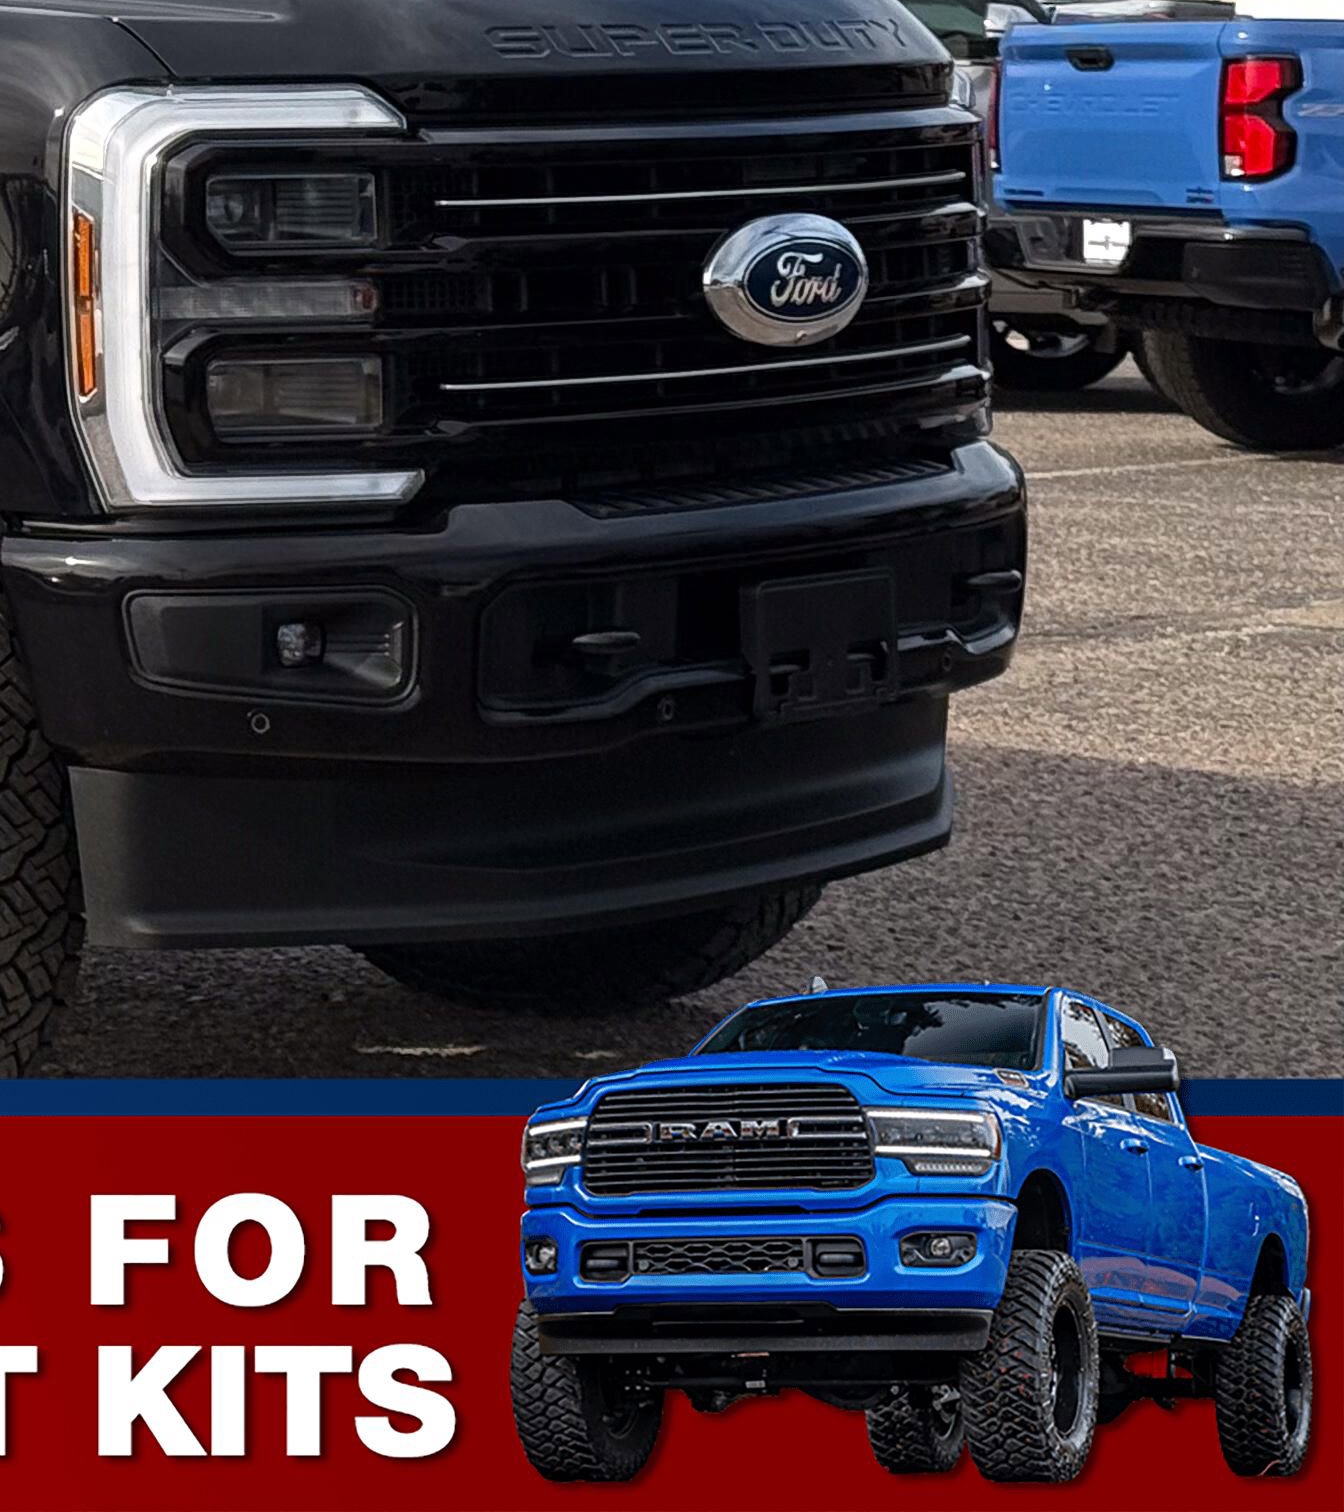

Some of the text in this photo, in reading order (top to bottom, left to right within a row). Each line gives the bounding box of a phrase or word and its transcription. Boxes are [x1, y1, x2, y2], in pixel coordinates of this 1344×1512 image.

[483, 18, 910, 59] SUPER DUTY
[770, 251, 844, 308] Ford
